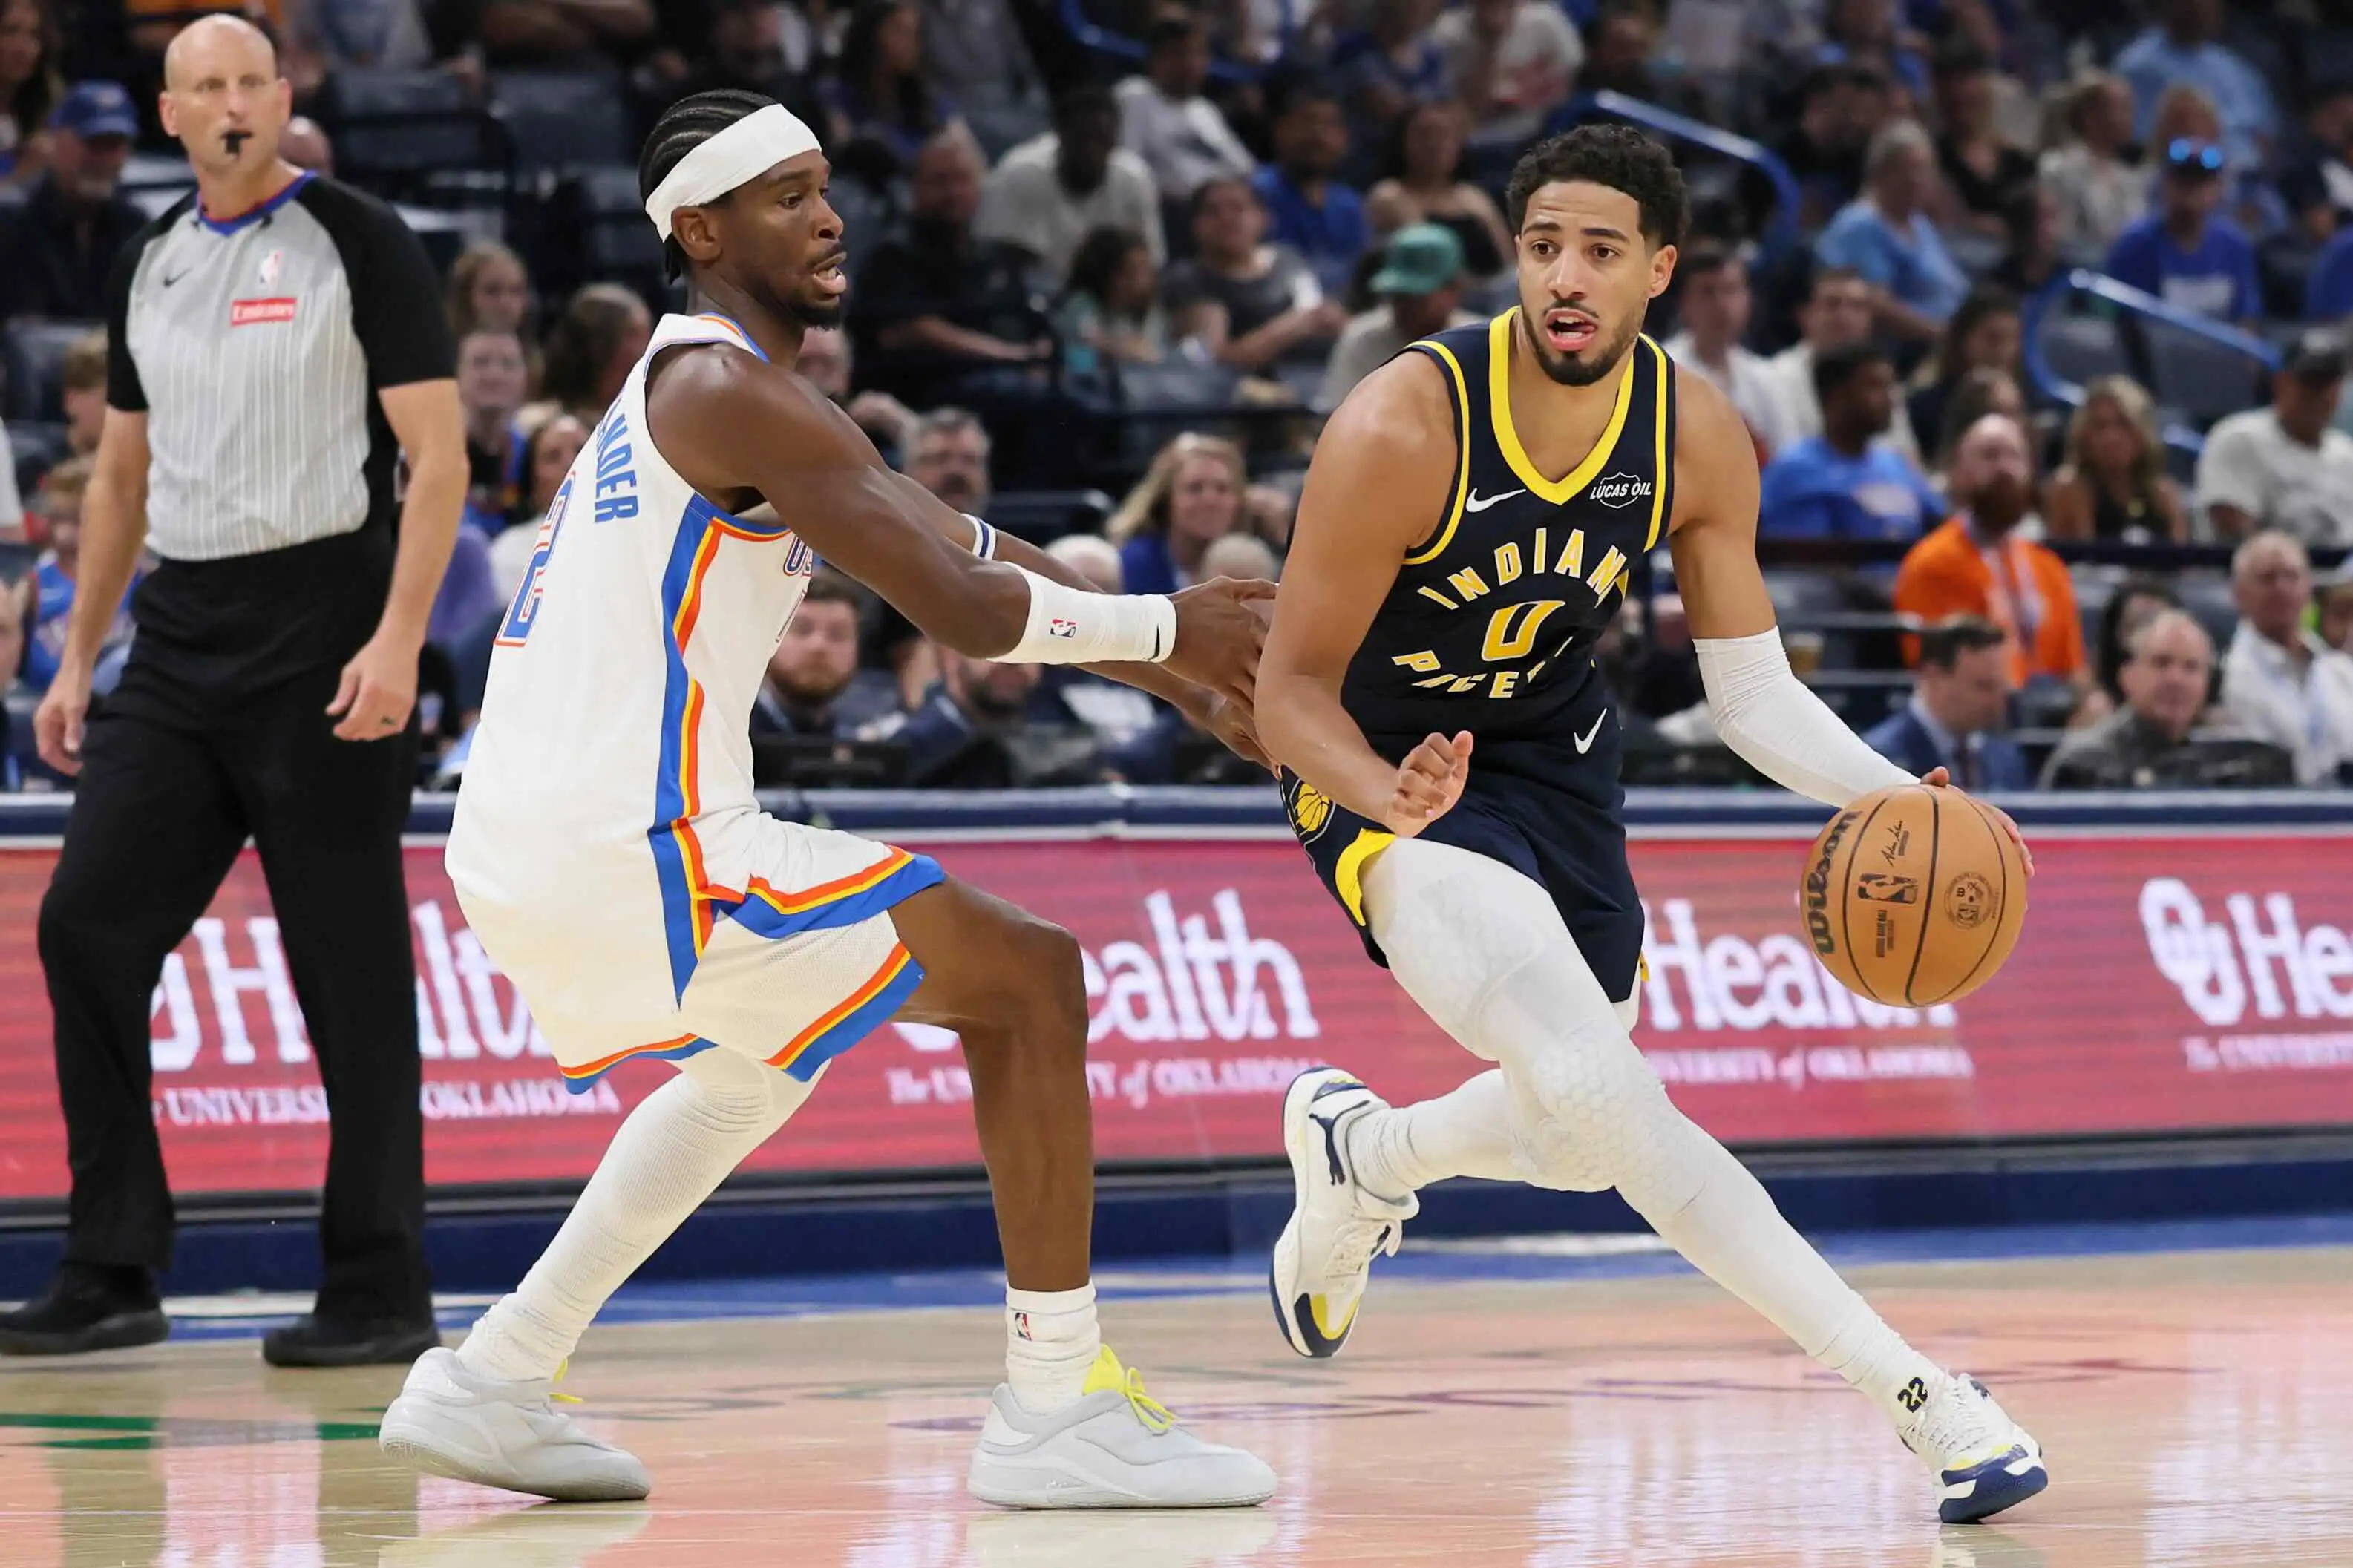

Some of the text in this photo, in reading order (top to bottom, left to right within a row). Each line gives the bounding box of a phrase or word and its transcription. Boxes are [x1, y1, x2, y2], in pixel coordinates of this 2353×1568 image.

[1589, 482, 1652, 499] LUCAS OIL
[1080, 888, 1321, 1043] alth
[1639, 890, 1958, 1031] Hea
[1153, 1056, 1332, 1096] OKLAHOM
[164, 1086, 330, 1126] UNIVERS
[1897, 1377, 1928, 1414] 22
